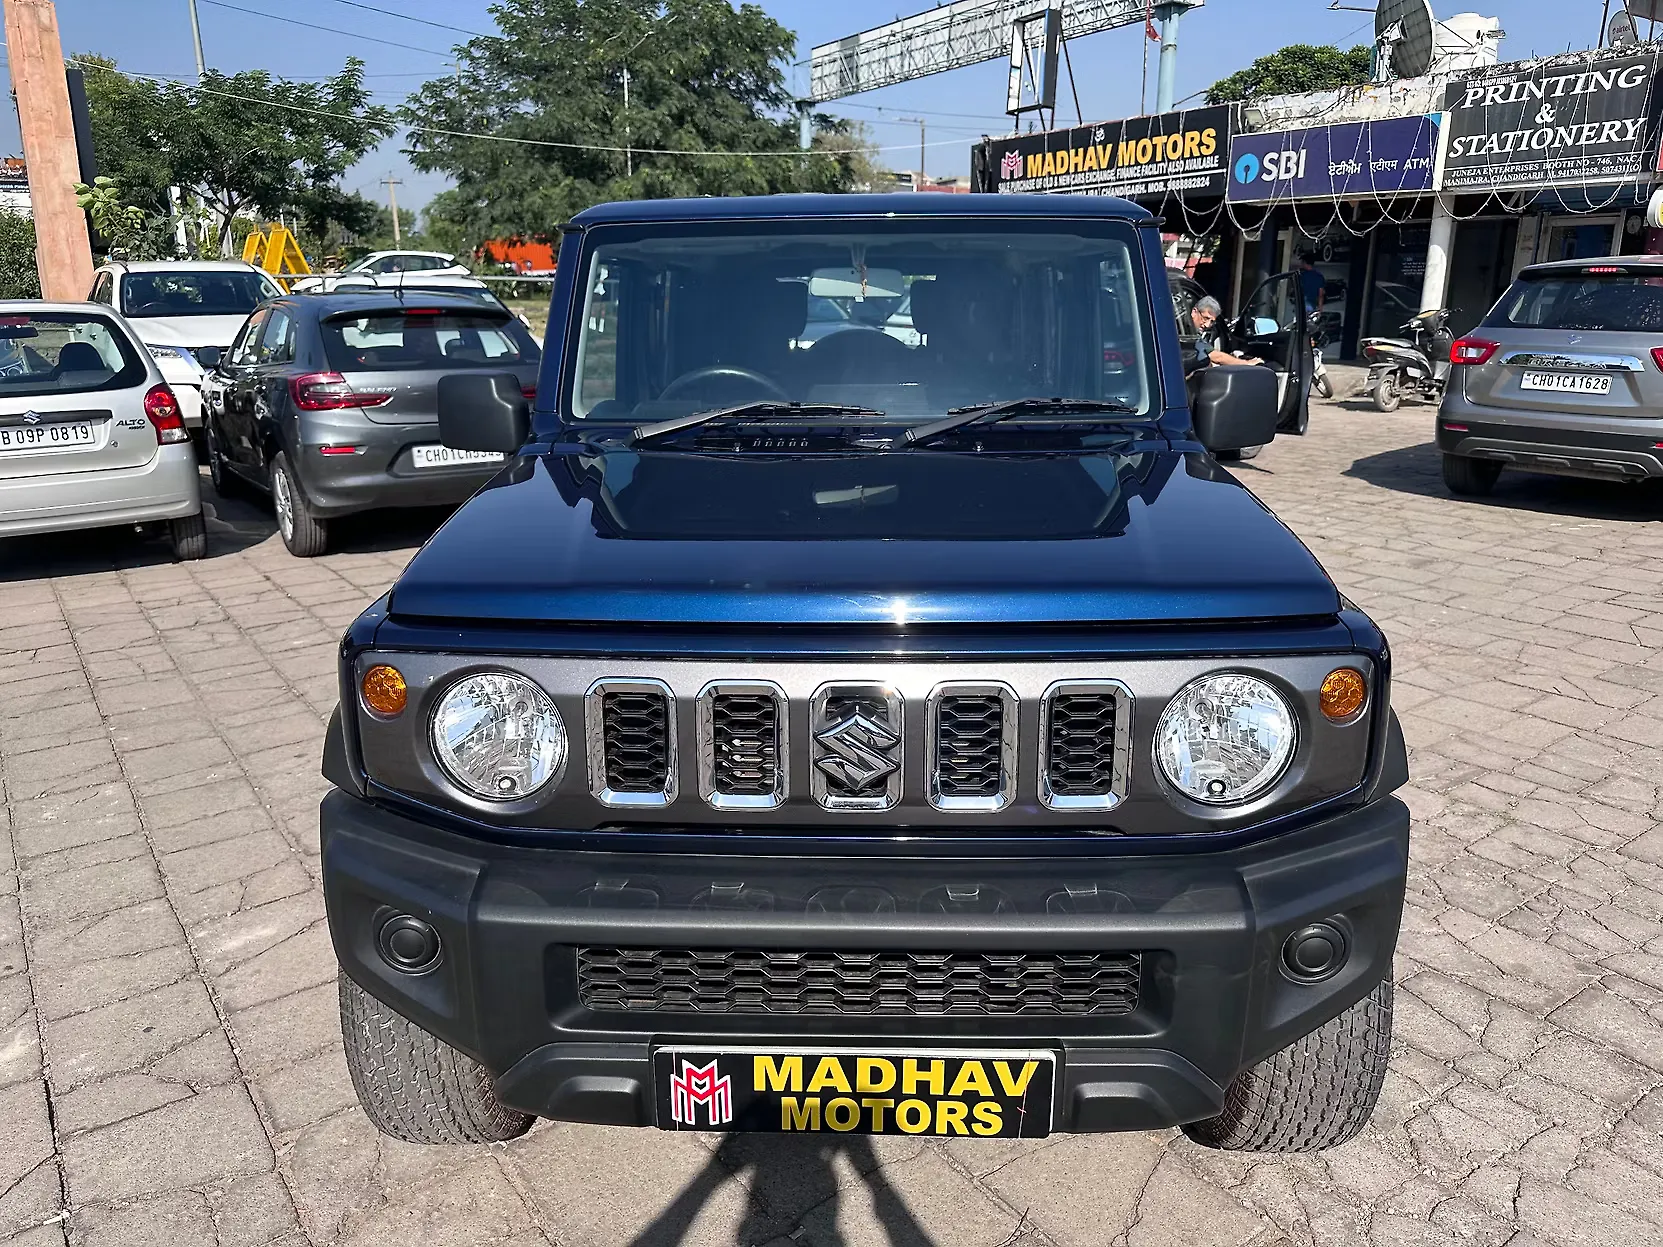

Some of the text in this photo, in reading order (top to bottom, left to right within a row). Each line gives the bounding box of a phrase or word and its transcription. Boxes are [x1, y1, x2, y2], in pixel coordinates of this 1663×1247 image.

[1460, 64, 1648, 109] PRINTING
[1535, 103, 1556, 124] &
[1027, 128, 1217, 178] MADHAV MOTORS
[1449, 118, 1648, 158] STATIONERY
[1059, 174, 1071, 186] NEW
[1071, 172, 1085, 185] CARS
[1117, 166, 1141, 180] FINANCE
[1141, 162, 1168, 177] FACILITY
[1168, 159, 1184, 173] ALSO
[1184, 155, 1219, 171] AVAILABLE
[1261, 149, 1307, 182] SBI
[1403, 158, 1430, 170] ATM
[1452, 168, 1481, 178] JUNEJA
[1482, 162, 1540, 176] ENTERPRISES
[1543, 159, 1574, 170] BOOTH
[1532, 373, 1609, 390] CH01CA1628
[16, 428, 44, 444] 09P
[50, 425, 89, 441] 0819
[115, 418, 146, 427] ALTO
[753, 1055, 1040, 1097] MADHAV
[781, 1096, 1004, 1136] MOTORS
